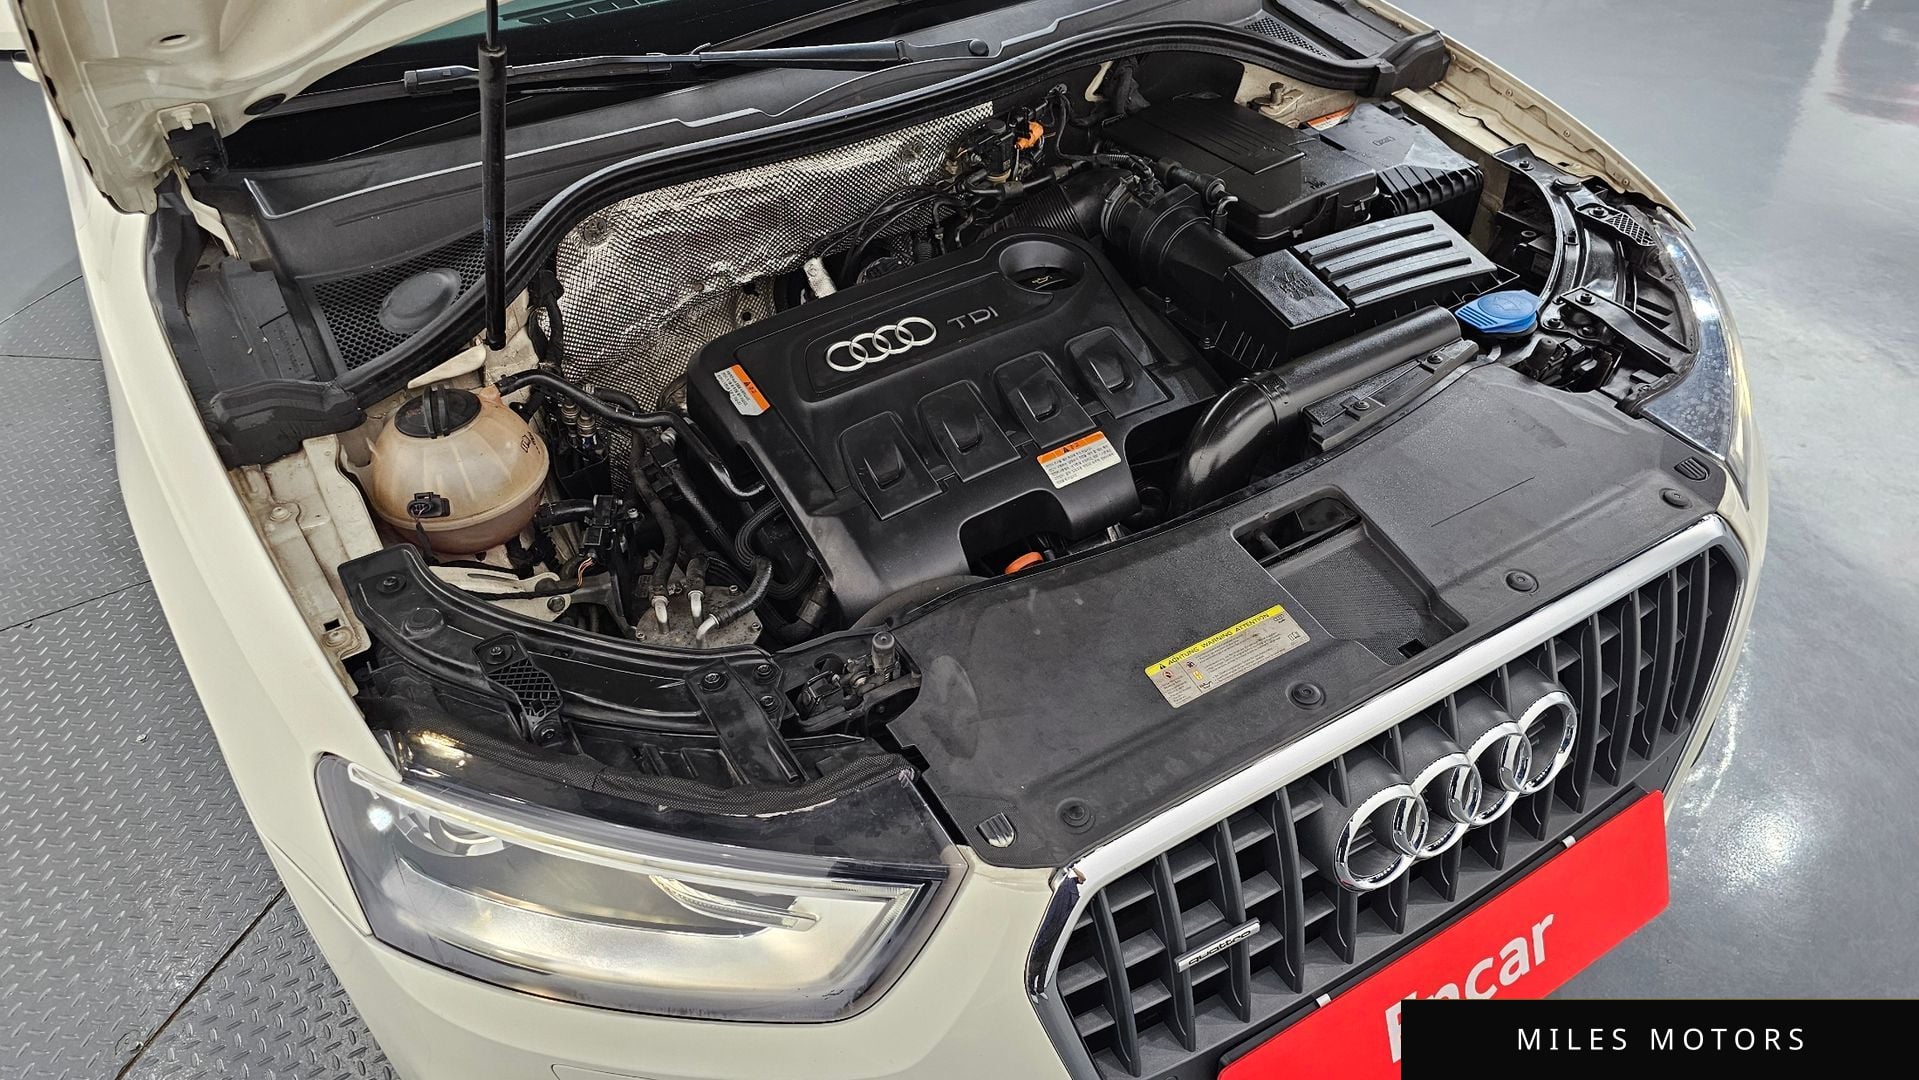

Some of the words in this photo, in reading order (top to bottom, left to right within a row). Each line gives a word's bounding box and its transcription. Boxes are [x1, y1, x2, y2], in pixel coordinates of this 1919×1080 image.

[947, 305, 999, 329] TDI
[1167, 647, 1200, 665] ACHTUNG
[1202, 630, 1233, 649] WARNING
[1235, 613, 1270, 632] ATTENTION
[1188, 930, 1251, 965] quattro
